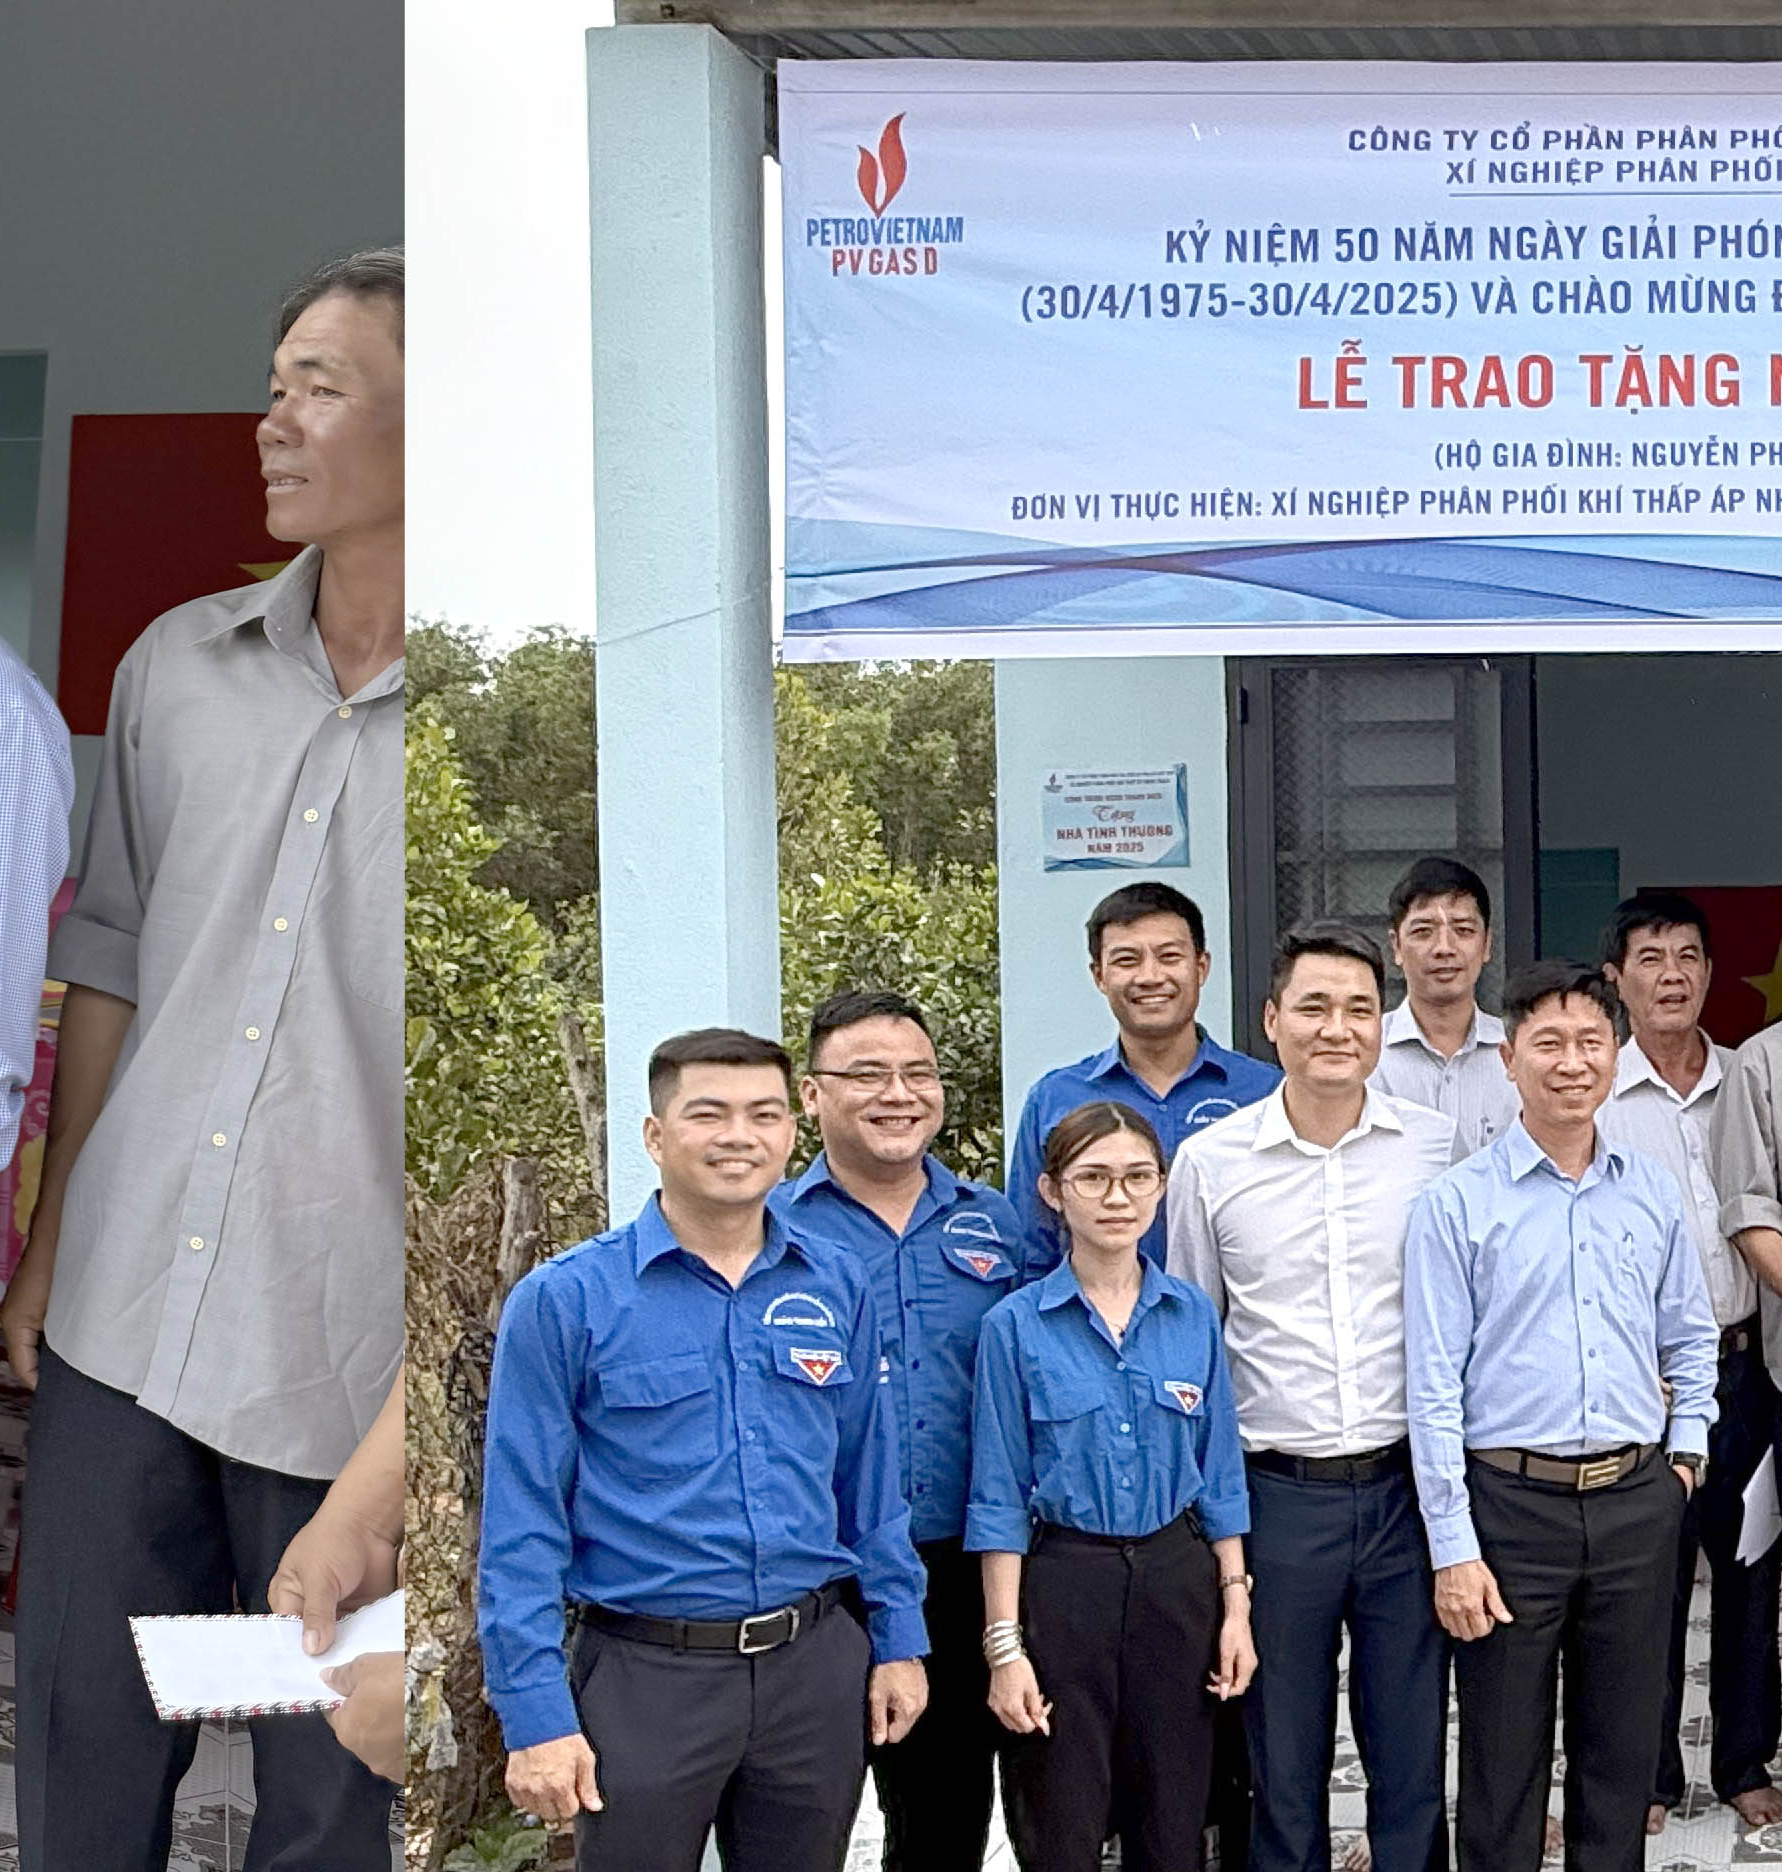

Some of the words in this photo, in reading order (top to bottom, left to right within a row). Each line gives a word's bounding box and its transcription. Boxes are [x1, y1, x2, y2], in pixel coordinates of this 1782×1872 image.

[1348, 124, 1431, 152] CÔNG
[1442, 129, 1479, 151] TY
[1490, 120, 1531, 151] CỔ
[1542, 122, 1624, 151] PHẦN
[1636, 124, 1717, 151] PHÂN
[1446, 157, 1477, 185] XÍ
[1488, 157, 1604, 187] NGHIỆP
[1616, 156, 1698, 183] PHÂN
[806, 216, 964, 248] PETROVIETNAM
[1165, 218, 1212, 264] KỶ
[1225, 222, 1320, 268] NIỆM
[1334, 227, 1379, 263] 50
[1394, 220, 1473, 262] NĂM
[1489, 219, 1588, 261] NGÀY
[1602, 213, 1676, 260] GIẢI
[1021, 281, 1458, 324] (30/4/1975-30/4/2025)
[1470, 275, 1518, 315] VÀ
[1532, 274, 1632, 315] CHÀO
[1647, 273, 1756, 314] MỪNG
[1298, 337, 1368, 410] LỄ
[1391, 354, 1554, 409] TRAO
[1578, 343, 1740, 416] TẶNG
[1434, 438, 1482, 472] (HỘ
[1492, 442, 1538, 468] GIA
[1546, 438, 1622, 468] ĐÌNH:
[1632, 434, 1739, 468] NGUYỄN
[1010, 492, 1066, 521] ĐƠN
[1074, 493, 1100, 522] VỊ
[1110, 490, 1180, 522] THỰC
[1189, 487, 1263, 521] HIỆN:
[1271, 486, 1298, 517] XÍ
[1308, 486, 1410, 519] NGHIỆP
[1420, 485, 1492, 515] PHÂN
[1502, 483, 1567, 515] PHỐI
[1578, 484, 1623, 514] KHÍ
[1632, 482, 1702, 514] THẤP
[1710, 484, 1746, 514] ÁP
